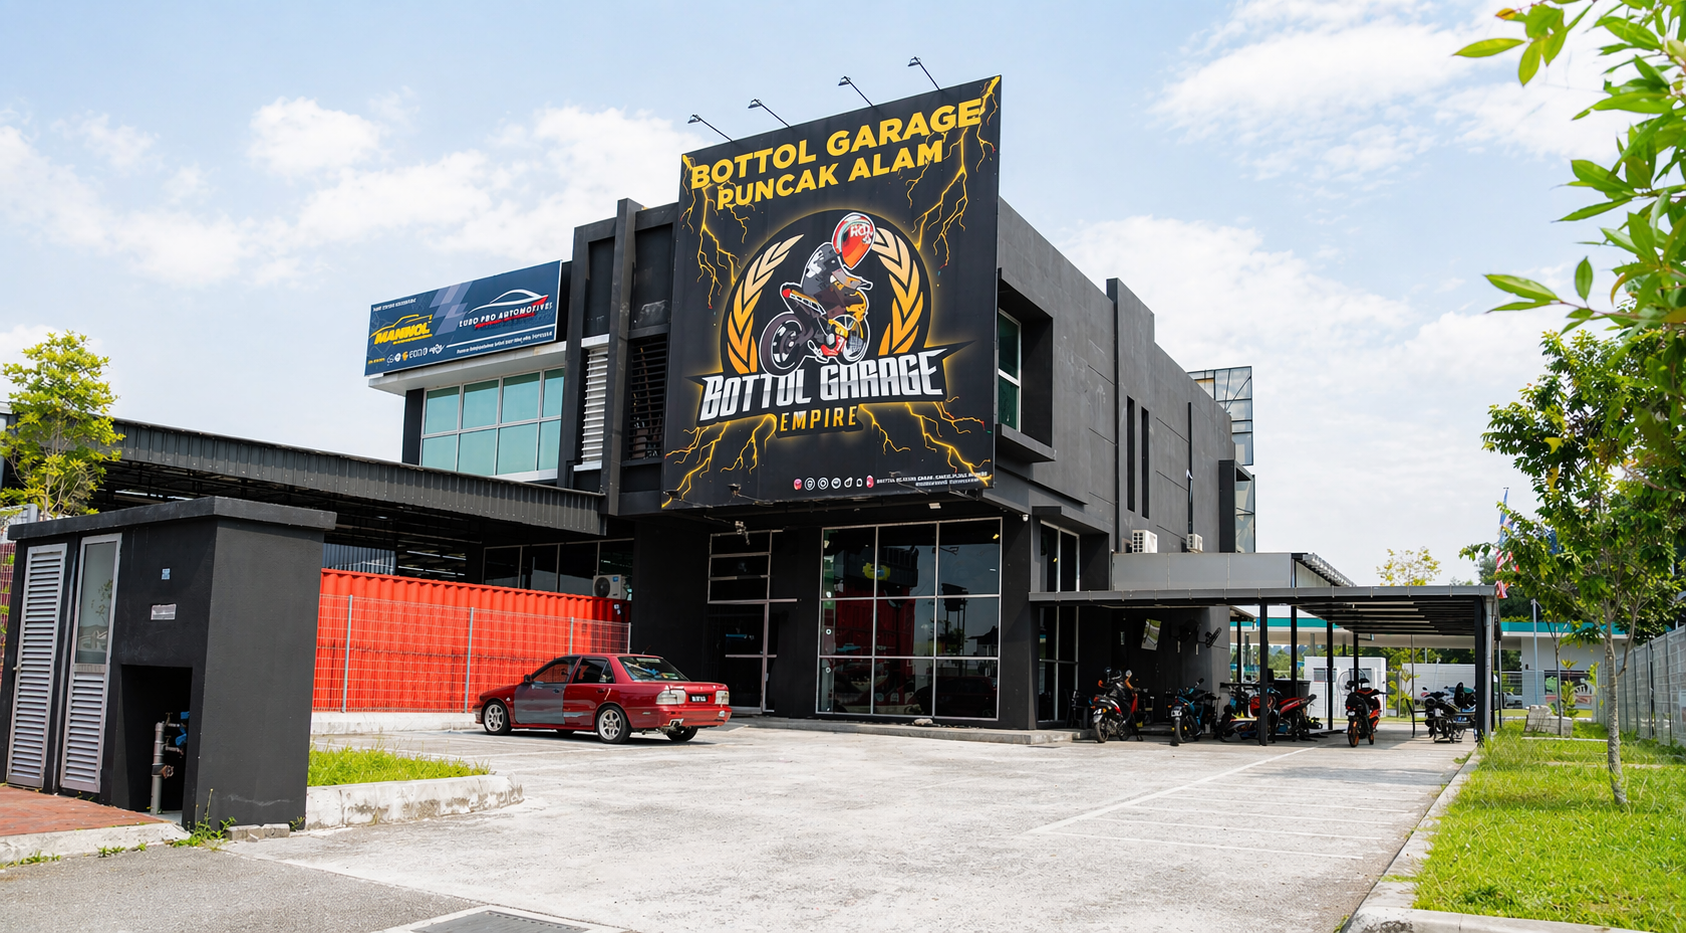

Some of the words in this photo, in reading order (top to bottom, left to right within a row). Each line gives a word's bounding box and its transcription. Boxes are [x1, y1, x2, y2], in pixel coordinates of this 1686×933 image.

[691, 140, 817, 190] BOTTOL
[827, 98, 982, 154] GARAGE
[717, 163, 839, 210] PUNCAK
[848, 140, 943, 181] ALAM
[374, 322, 431, 345] MANNOL
[699, 368, 812, 421] BOTTOL
[820, 349, 948, 401] GARAGE
[780, 405, 858, 432] EMPIRE
